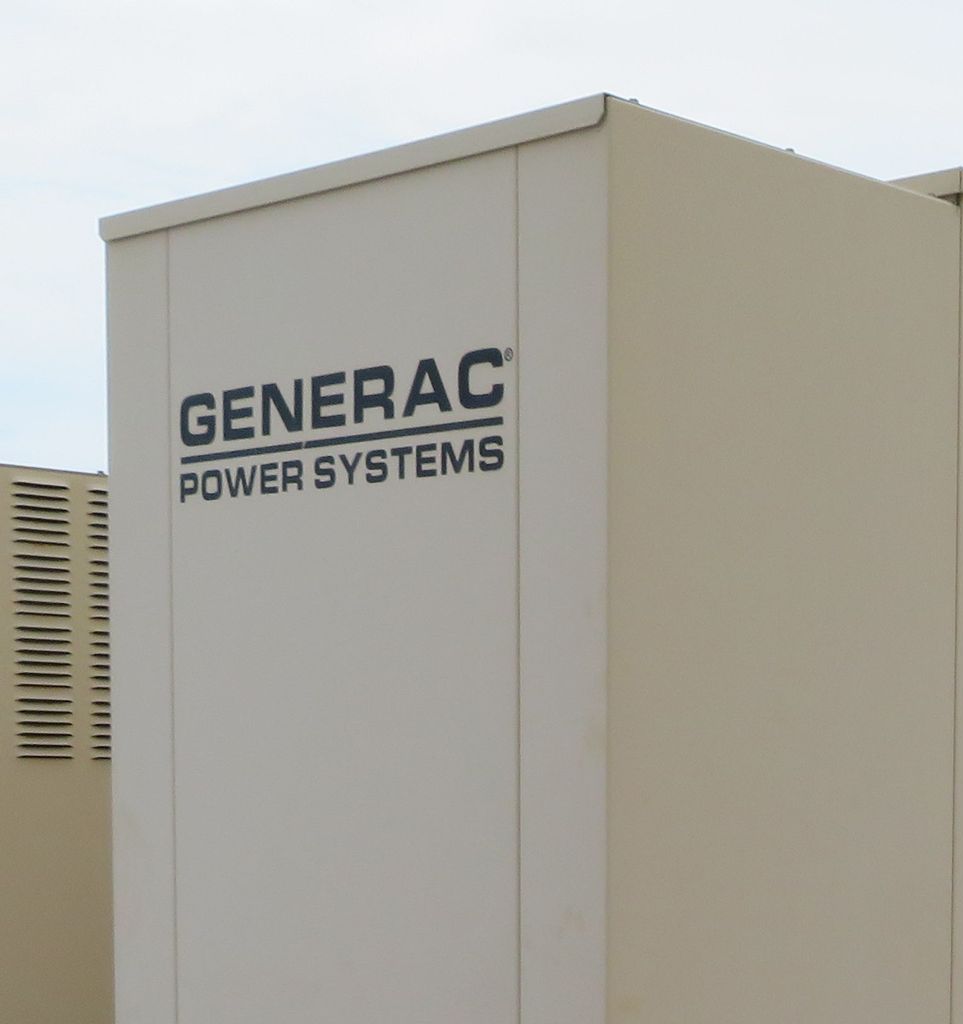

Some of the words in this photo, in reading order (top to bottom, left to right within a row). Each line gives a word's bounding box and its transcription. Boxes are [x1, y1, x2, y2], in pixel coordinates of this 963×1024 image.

[180, 347, 504, 447] GENERAC
[180, 459, 303, 503] POWER
[314, 435, 504, 490] SYSTEMS
